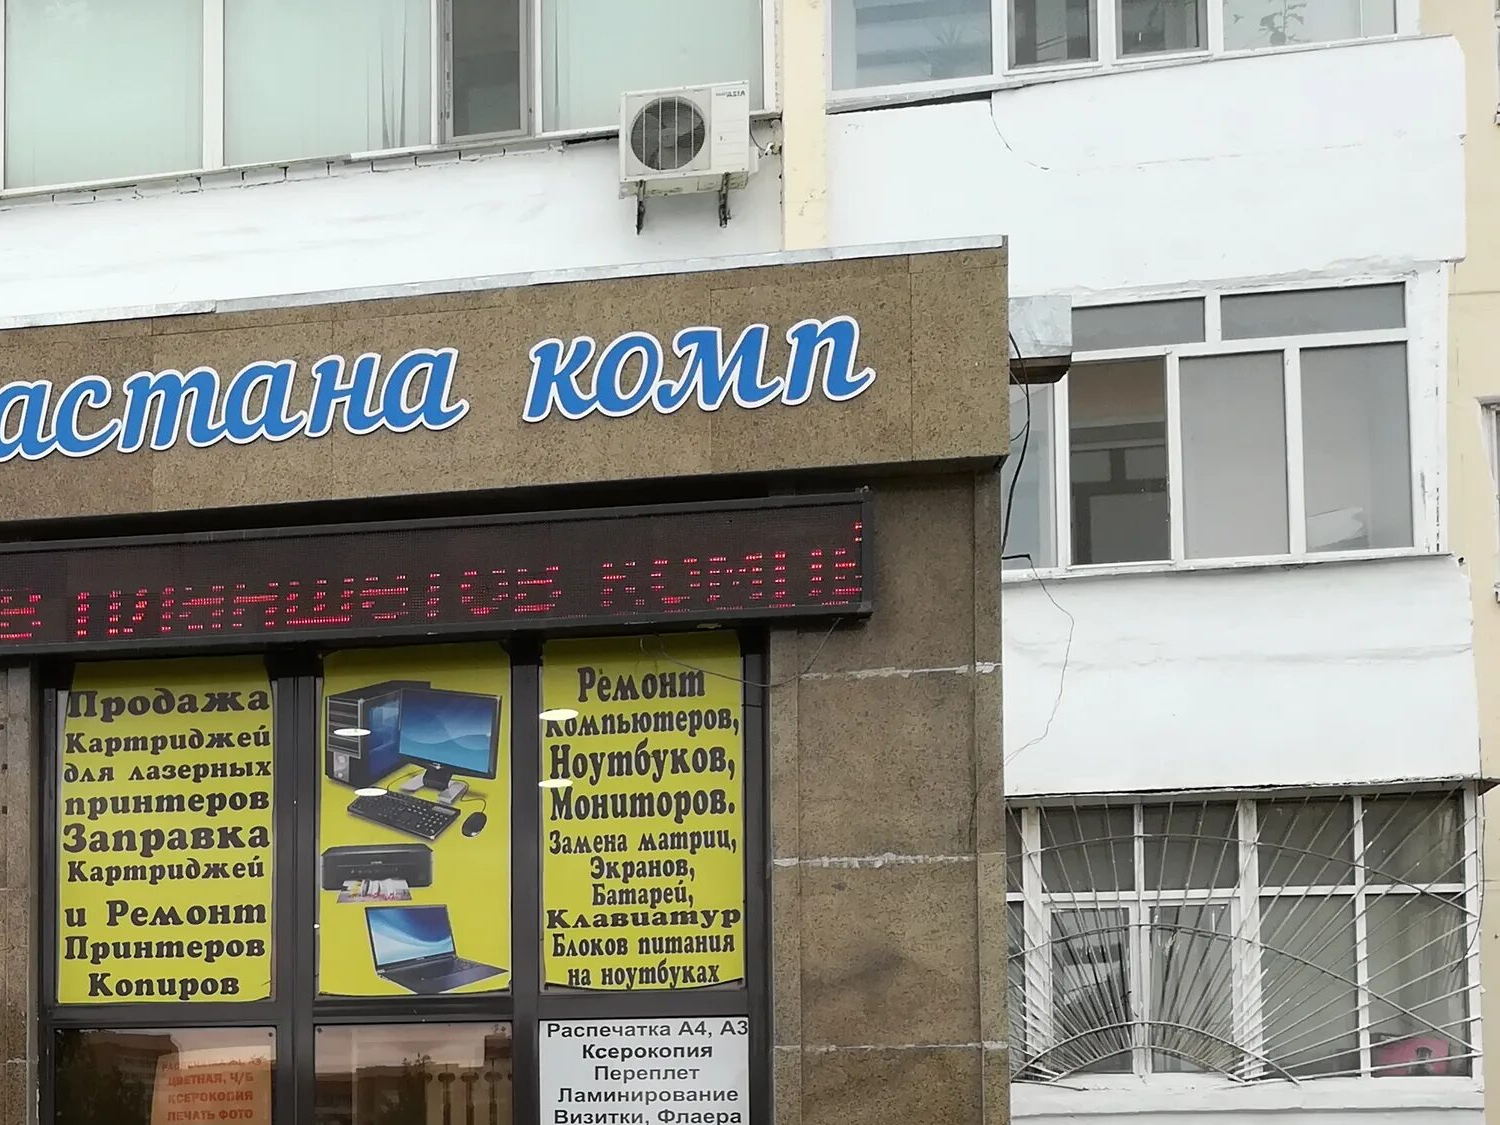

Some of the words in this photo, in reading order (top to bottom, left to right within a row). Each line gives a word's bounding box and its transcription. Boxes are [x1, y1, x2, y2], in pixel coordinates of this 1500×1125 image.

[521, 314, 876, 424] комп
[578, 666, 706, 702] Ремонт
[67, 688, 271, 722] Продажа
[545, 707, 739, 737] Компьютеров,
[65, 725, 271, 757] Картриджей
[64, 762, 115, 783] для
[128, 760, 272, 783] лазерных
[550, 737, 735, 785] Ноутбуков,
[65, 790, 270, 820] принтеров
[550, 786, 735, 824] Мониторов.
[63, 823, 271, 858] Заправка
[550, 829, 628, 855] Замена
[638, 828, 737, 855] матриц,
[67, 855, 265, 886] Картриджей
[591, 855, 695, 883] Экранов,
[592, 879, 694, 909] Батарей,
[65, 907, 87, 927] и
[106, 900, 266, 927] Ремонт
[546, 908, 742, 929] Клавиатур
[64, 935, 266, 965] Принтеров
[552, 933, 628, 957] Блоков
[638, 933, 736, 955] питания
[88, 972, 240, 1000] Копиров
[568, 967, 591, 986] на
[601, 958, 720, 991] ноутбуках
[547, 1023, 671, 1038] Распечатка
[582, 1044, 713, 1062] Ксерокопия
[594, 1066, 701, 1084] Переплет
[168, 1090, 253, 1104] КСЕРОКОПИЯ
[558, 1087, 739, 1105] Ламинирование
[167, 1110, 216, 1121] ПЕЧАТЬ
[219, 1109, 254, 1120] ФОТО
[554, 1109, 650, 1125] Визитки,
